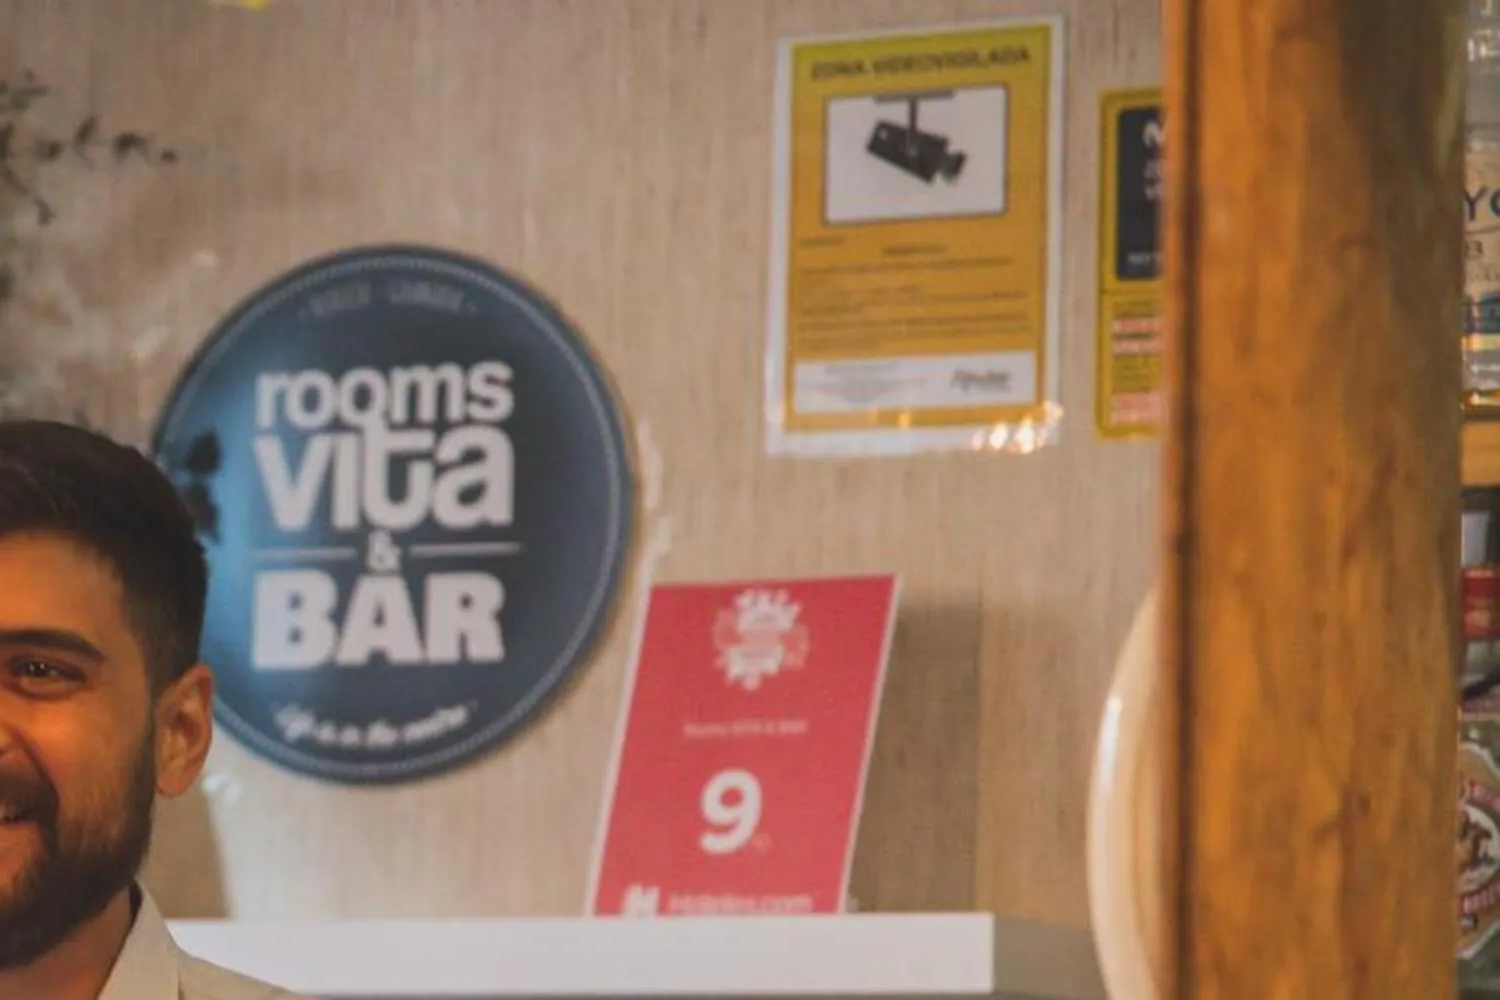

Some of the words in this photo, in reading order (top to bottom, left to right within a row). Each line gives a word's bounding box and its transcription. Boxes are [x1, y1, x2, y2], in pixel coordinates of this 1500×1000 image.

[254, 359, 514, 430] rooms
[365, 530, 401, 572] &
[250, 567, 506, 671] BAR
[700, 769, 762, 854] 9
